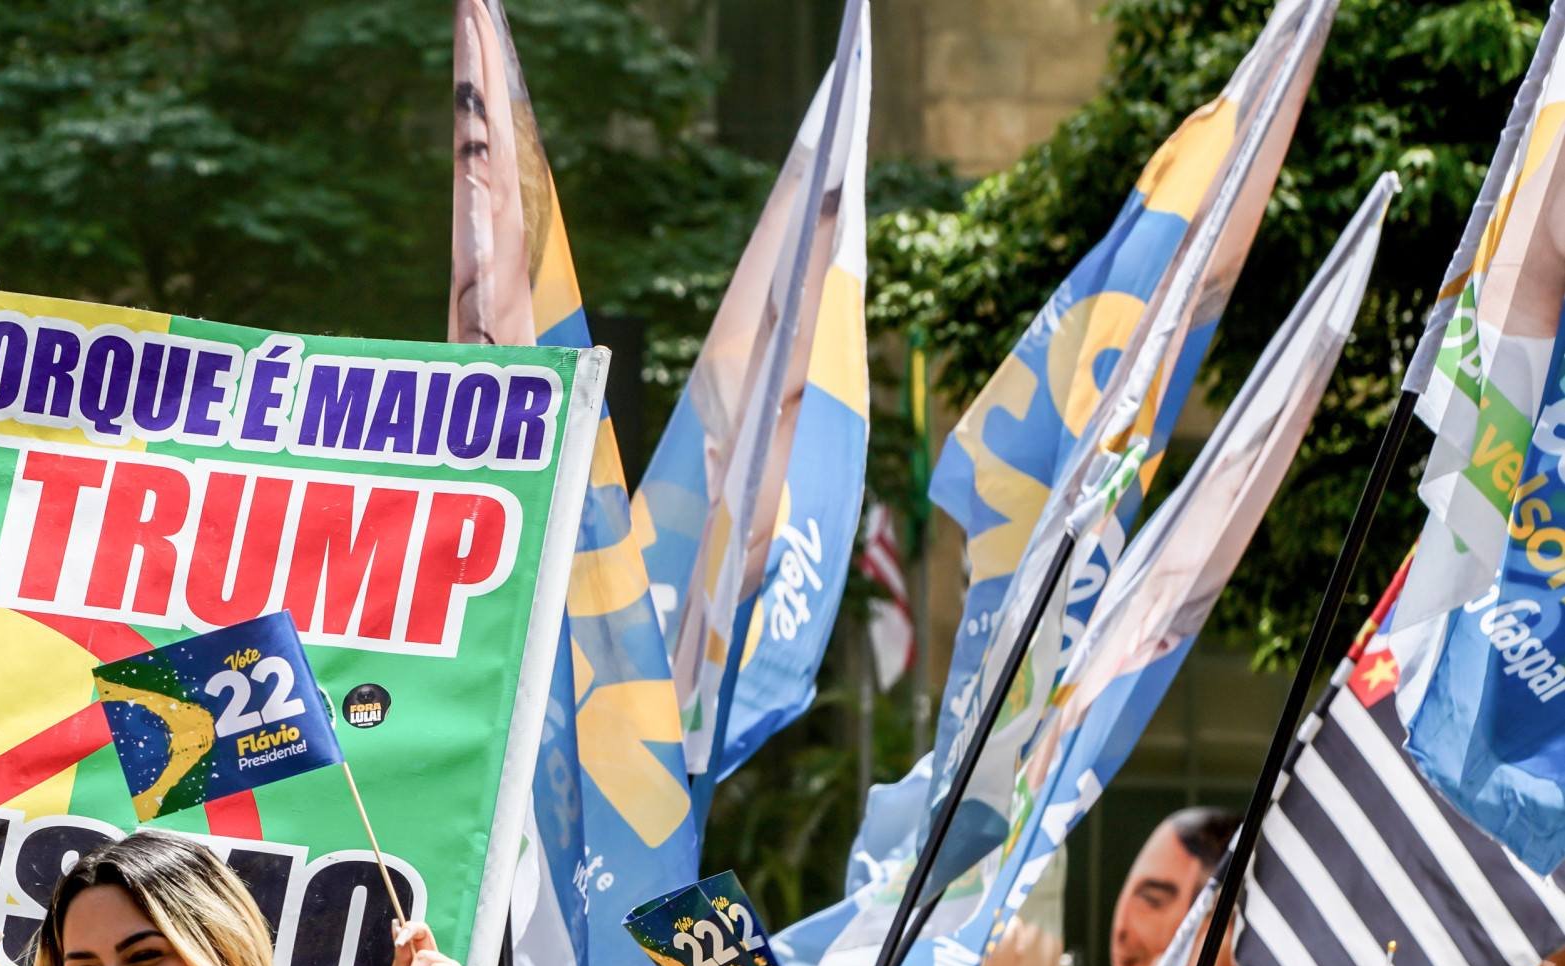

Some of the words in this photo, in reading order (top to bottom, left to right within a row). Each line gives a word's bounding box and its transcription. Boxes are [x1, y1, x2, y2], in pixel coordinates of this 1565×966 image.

[240, 345, 298, 442] É
[297, 365, 552, 460] MAIOR
[771, 517, 824, 642] Vote
[224, 648, 261, 673] Vote
[204, 656, 306, 738] 22
[350, 702, 382, 713] FORA
[237, 723, 300, 757] Flávio
[238, 739, 308, 771] Presidente!
[674, 916, 694, 933] Vote
